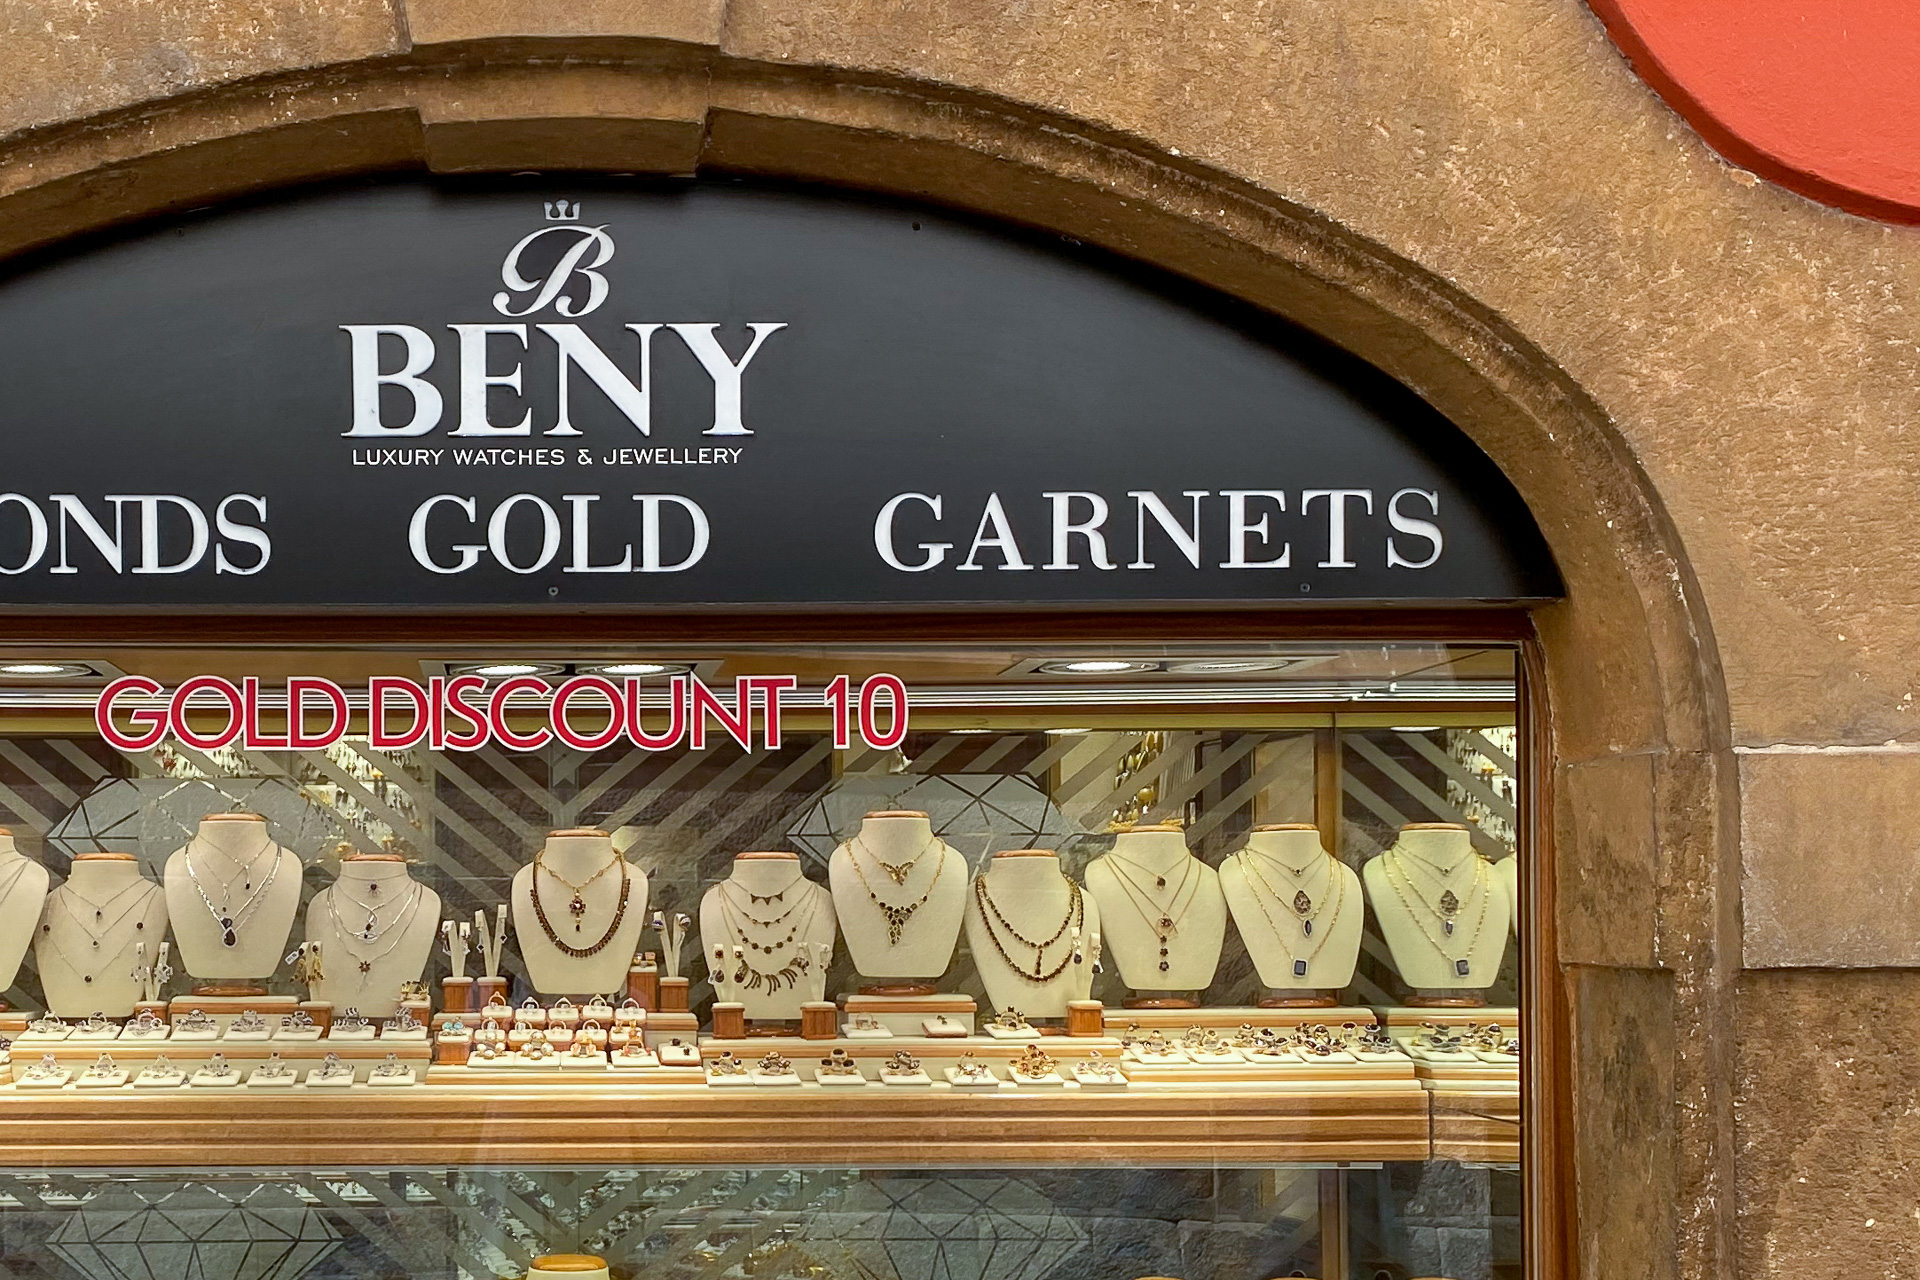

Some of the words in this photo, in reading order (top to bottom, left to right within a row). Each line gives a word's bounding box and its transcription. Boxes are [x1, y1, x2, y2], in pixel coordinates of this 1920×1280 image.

[338, 322, 788, 437] BENY
[352, 448, 445, 466] LUXURY
[453, 448, 566, 466] WATCHES
[577, 448, 593, 466] &
[602, 447, 744, 466] JEWELLERY
[0, 492, 271, 576] ONDS
[408, 492, 710, 575] GOLD
[874, 487, 1443, 572] GARNETS
[95, 675, 350, 752] GOLD
[368, 673, 798, 753] DISCOUNT
[823, 673, 909, 751] 10
